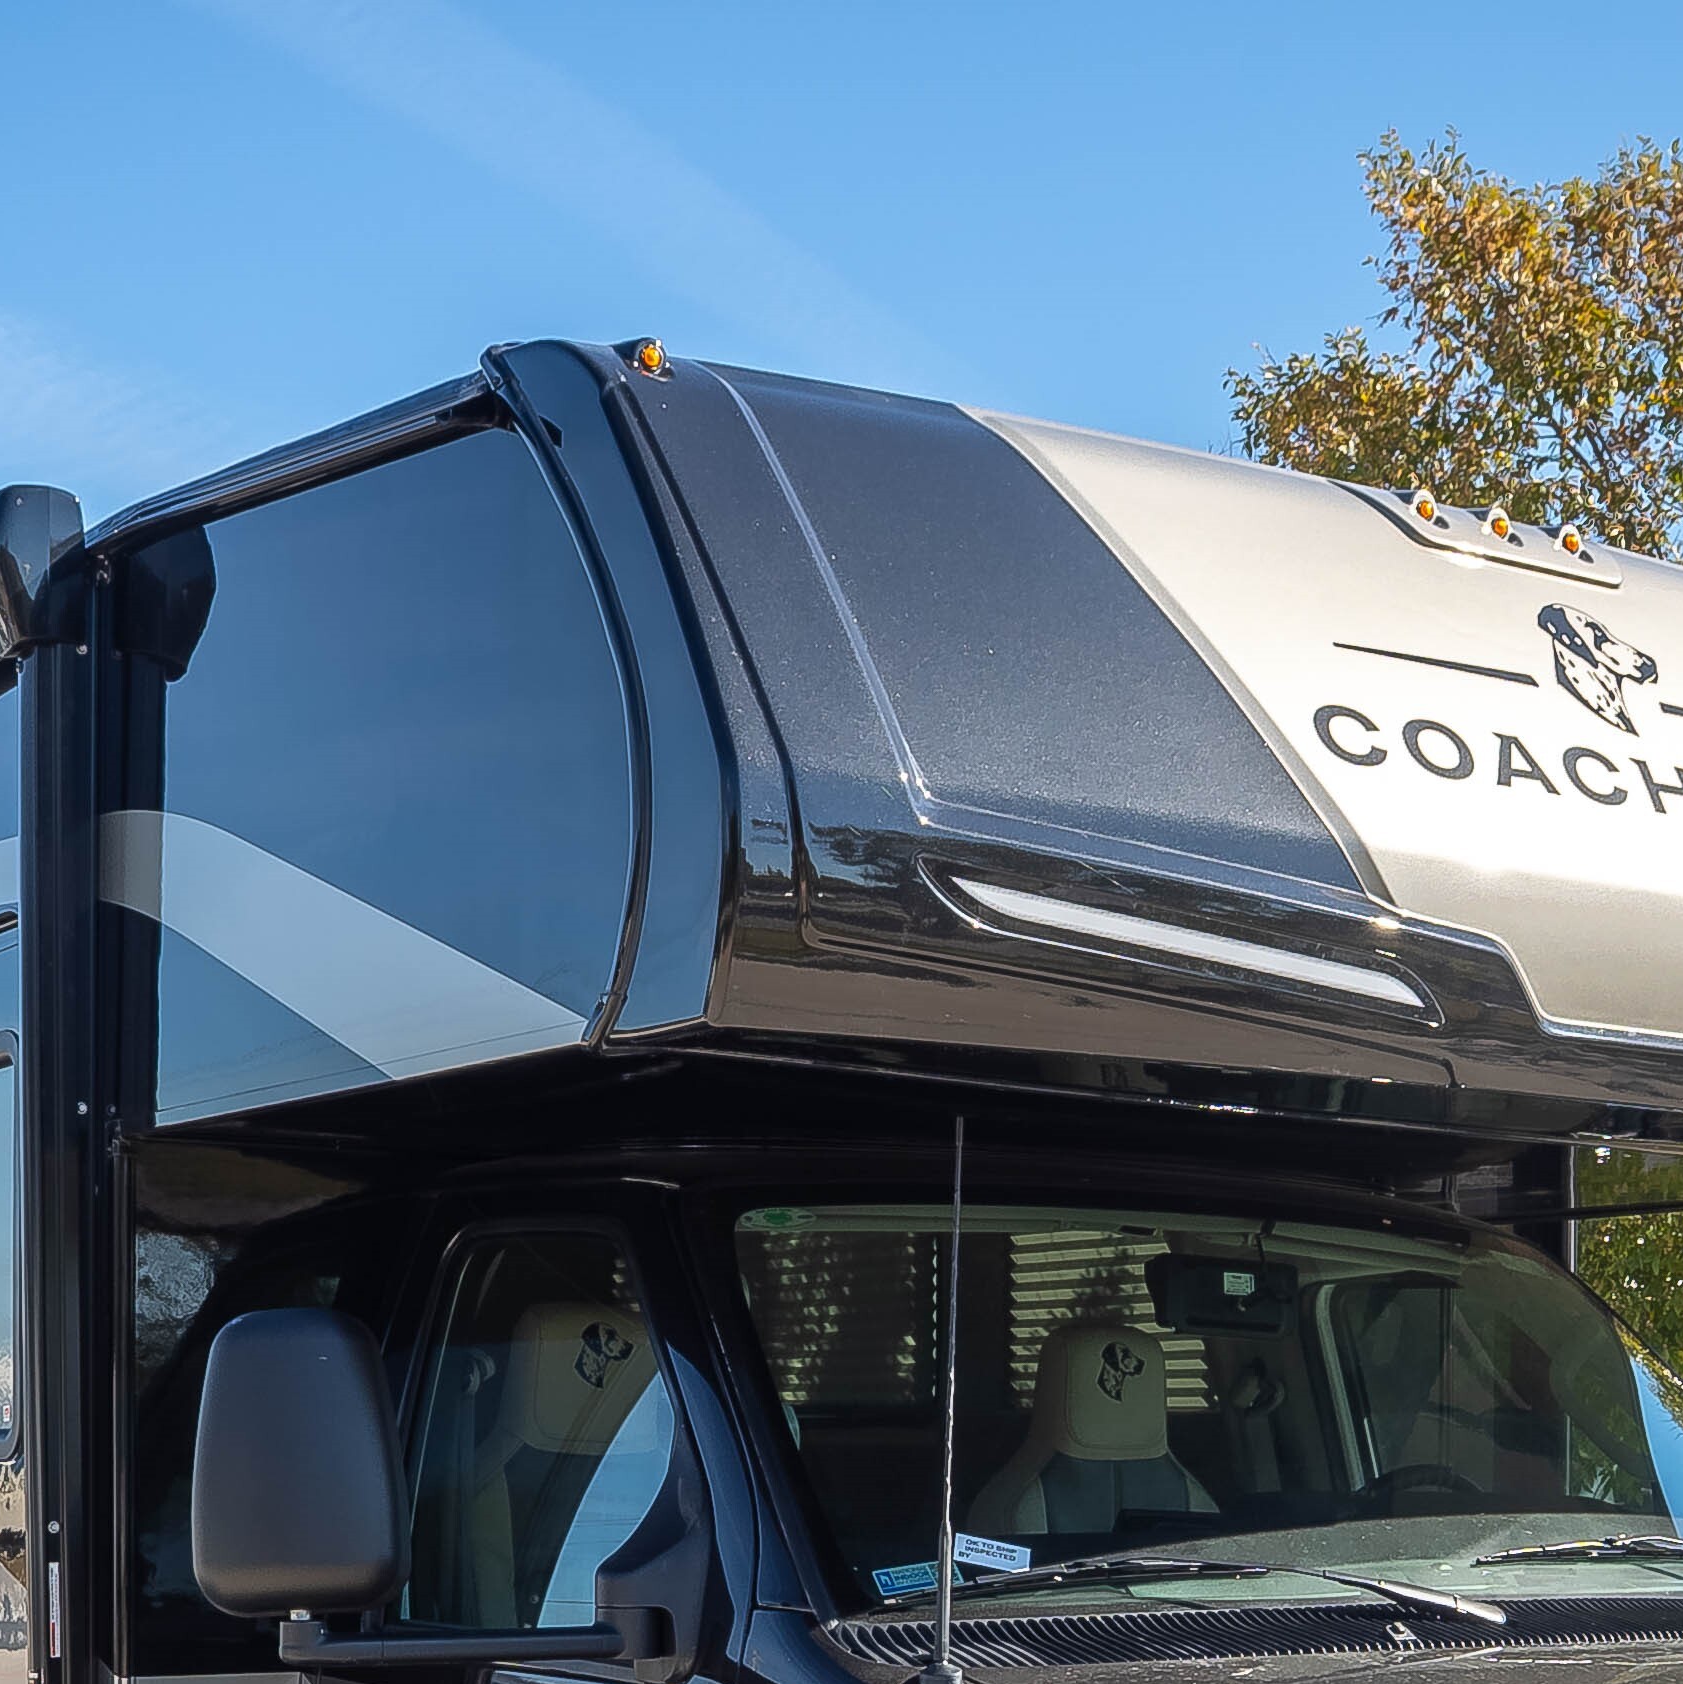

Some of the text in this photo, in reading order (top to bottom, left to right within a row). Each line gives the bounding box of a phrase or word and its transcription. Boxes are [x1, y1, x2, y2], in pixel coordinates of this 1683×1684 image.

[964, 1546, 1016, 1561] INSPECTED
[965, 1538, 1018, 1554] OK TO SHIP
[958, 1550, 972, 1559] BY
